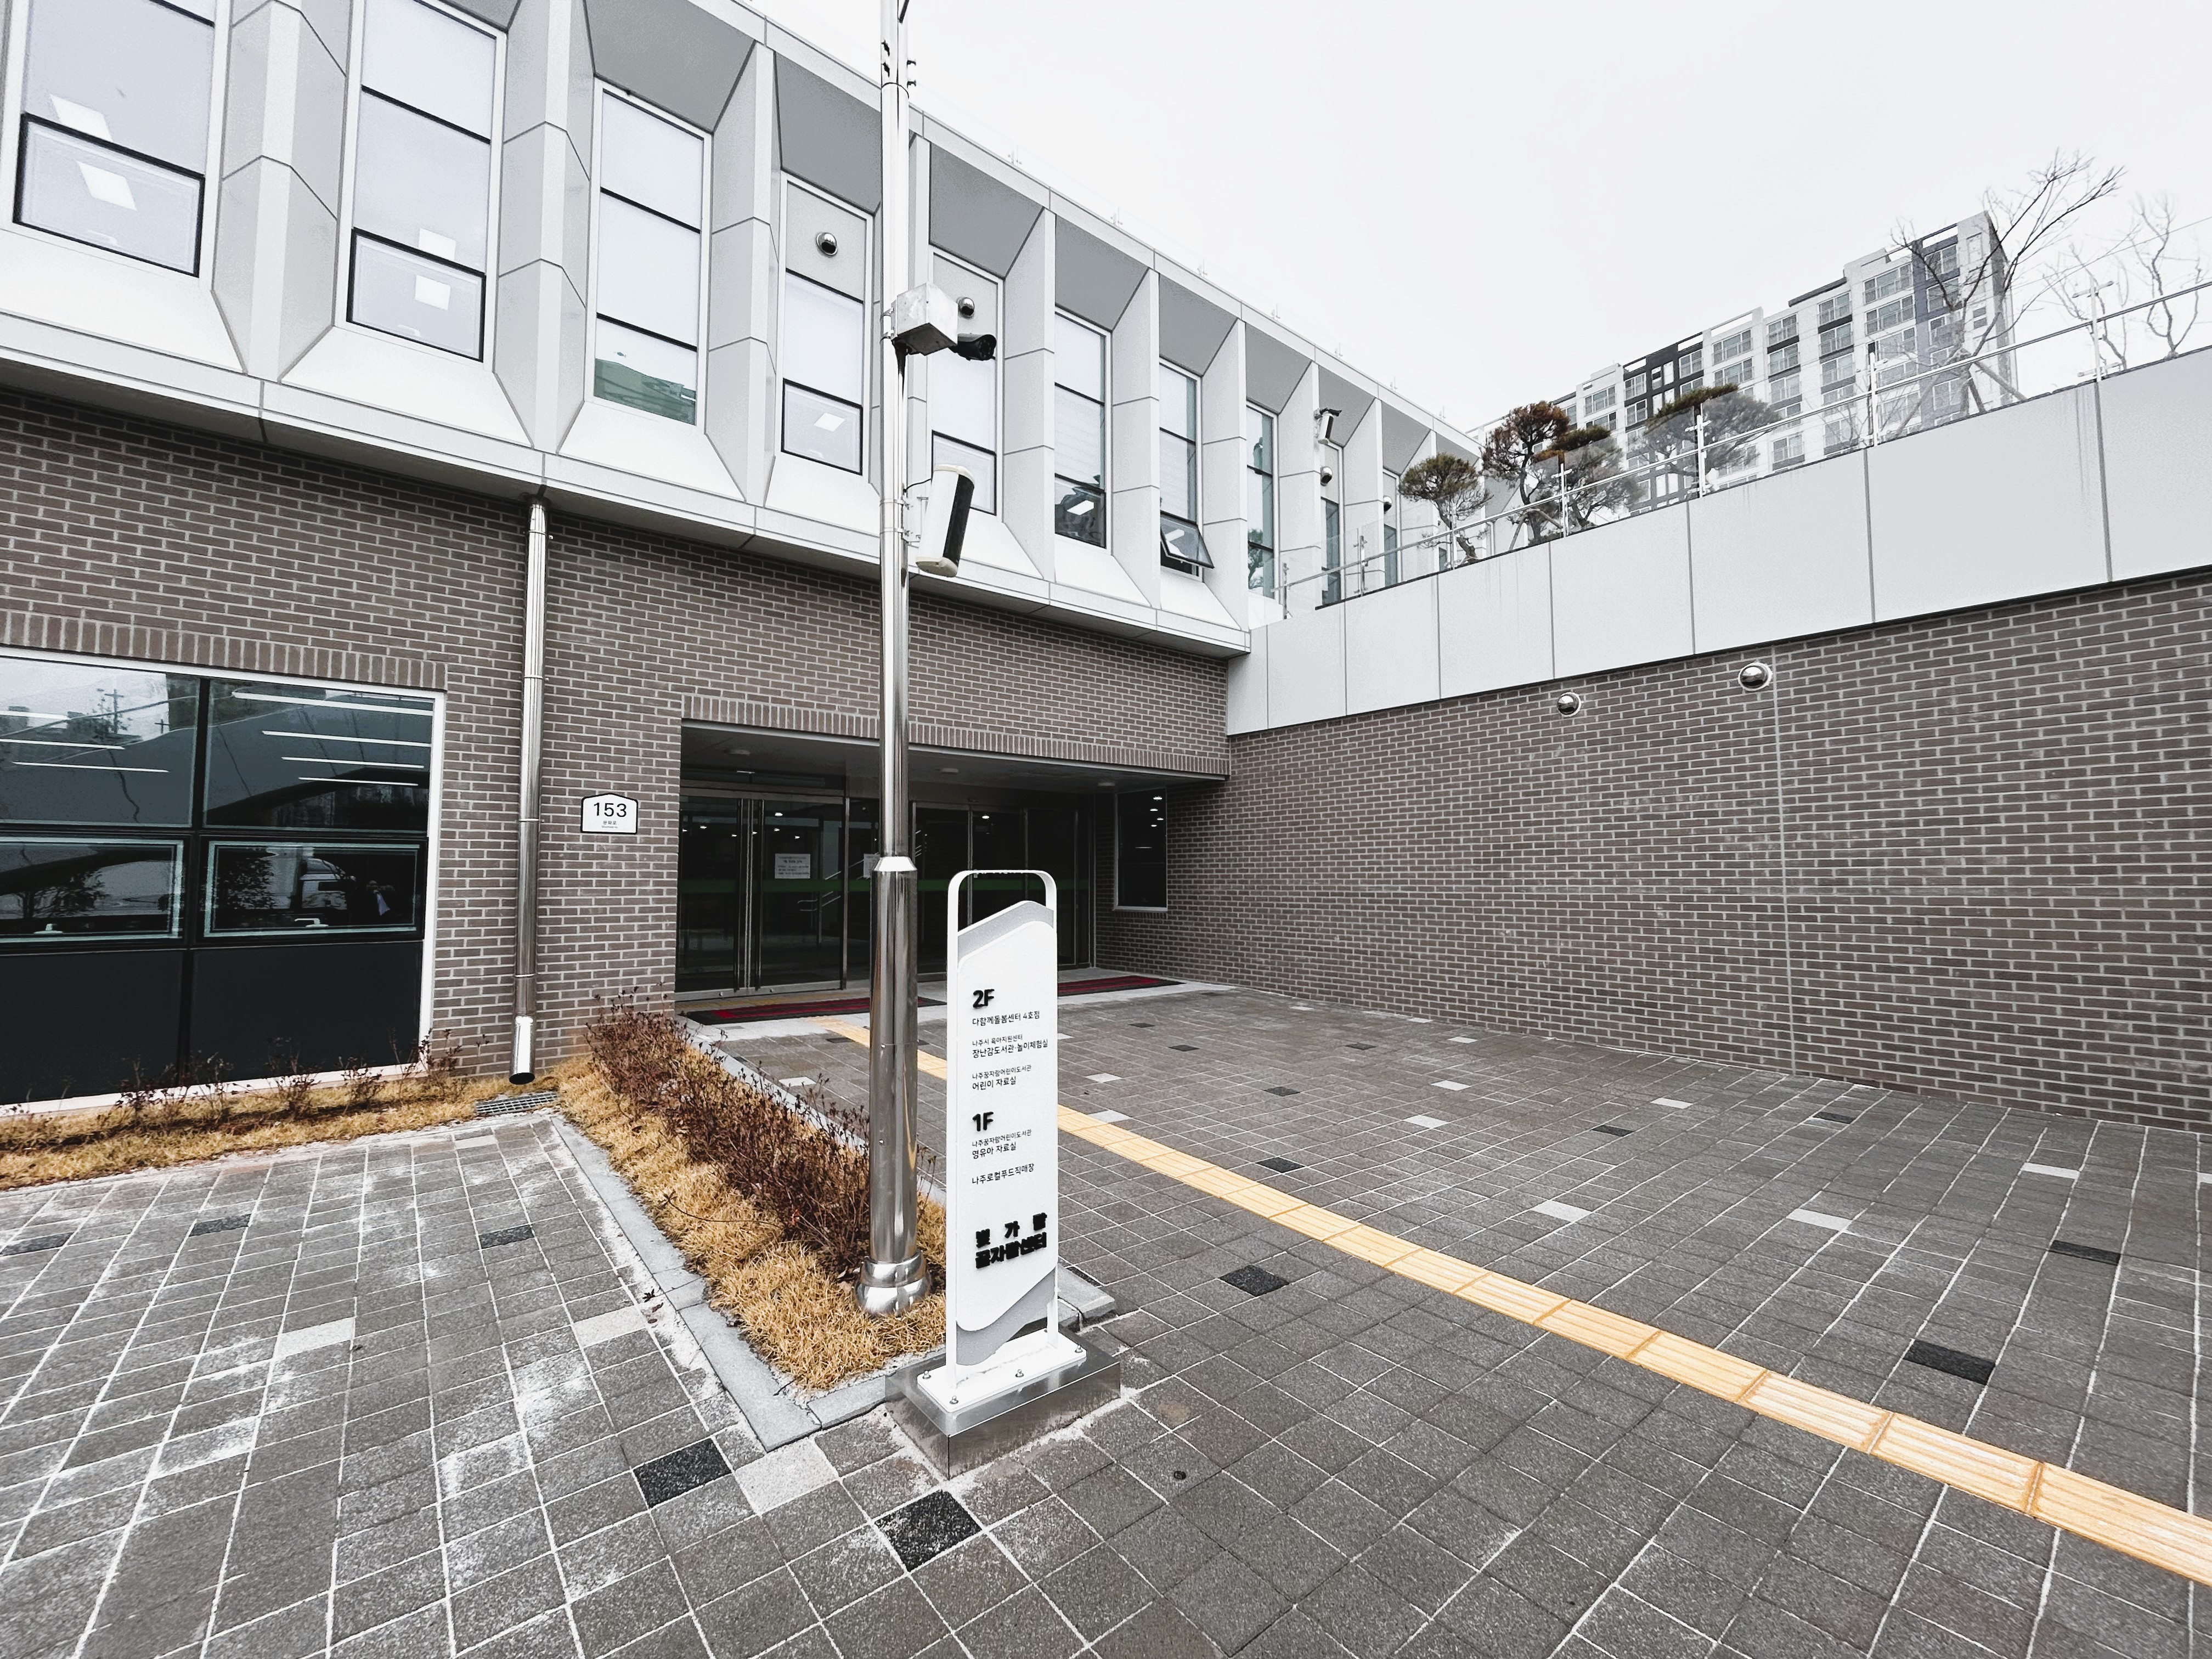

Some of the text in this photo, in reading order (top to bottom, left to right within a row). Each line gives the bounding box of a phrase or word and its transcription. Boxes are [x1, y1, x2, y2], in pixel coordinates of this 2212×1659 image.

[594, 802, 627, 817] 153
[973, 989, 995, 1008] 2F
[972, 1011, 1040, 1026] 다함께돌봄센터 4호점
[972, 1076, 1017, 1091] 어린이 자료실
[972, 1111, 994, 1131] 1F
[972, 1142, 1017, 1159] 영유아 자료실
[972, 1163, 1035, 1184] 나주로컬푸드직매장
